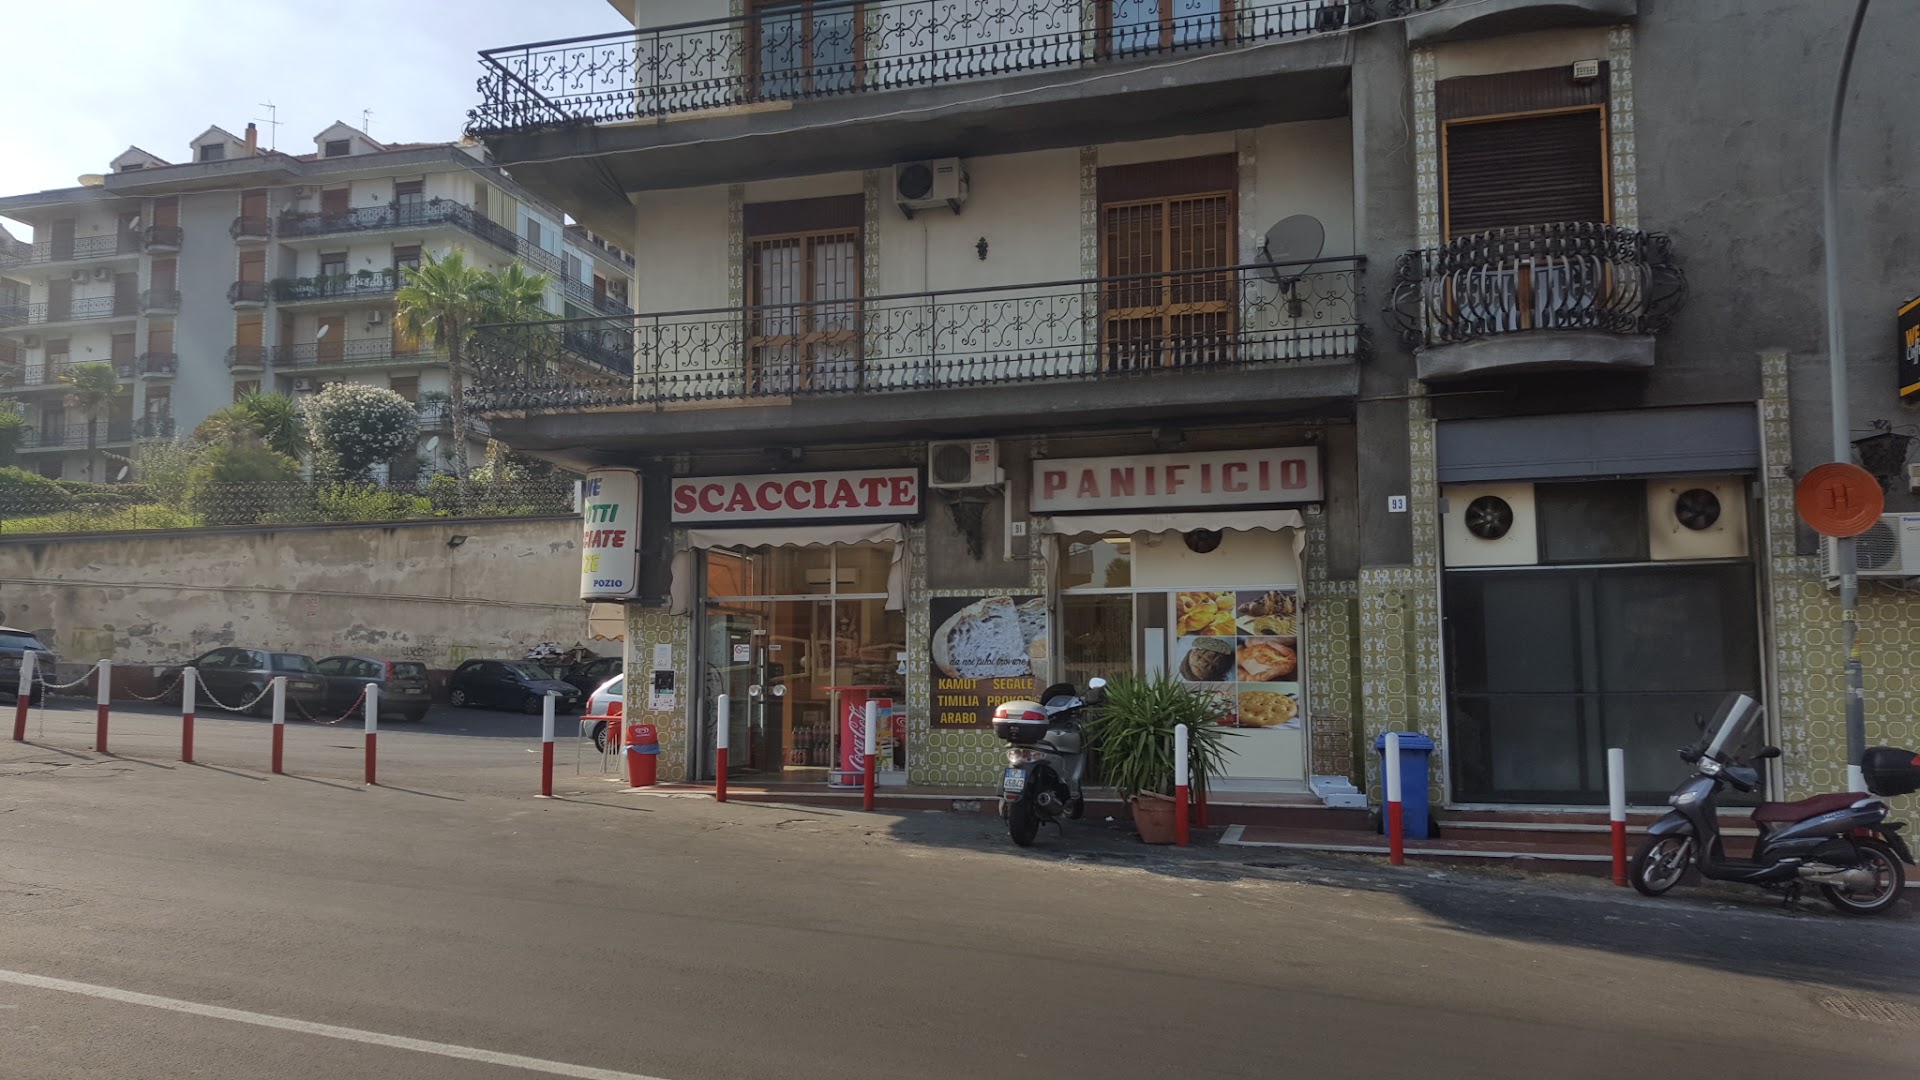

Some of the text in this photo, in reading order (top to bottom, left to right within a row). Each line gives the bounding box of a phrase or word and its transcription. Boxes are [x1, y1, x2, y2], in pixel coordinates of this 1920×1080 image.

[1044, 459, 1307, 499] PANIFICIO
[674, 476, 916, 513] SCACCIATE
[1392, 499, 1403, 509] 93
[593, 579, 623, 588] POZIO
[961, 657, 975, 666] noi
[938, 678, 1033, 690] KAMUT SEGALE
[937, 695, 980, 707] TIMILIA
[940, 712, 977, 724] ARABO
